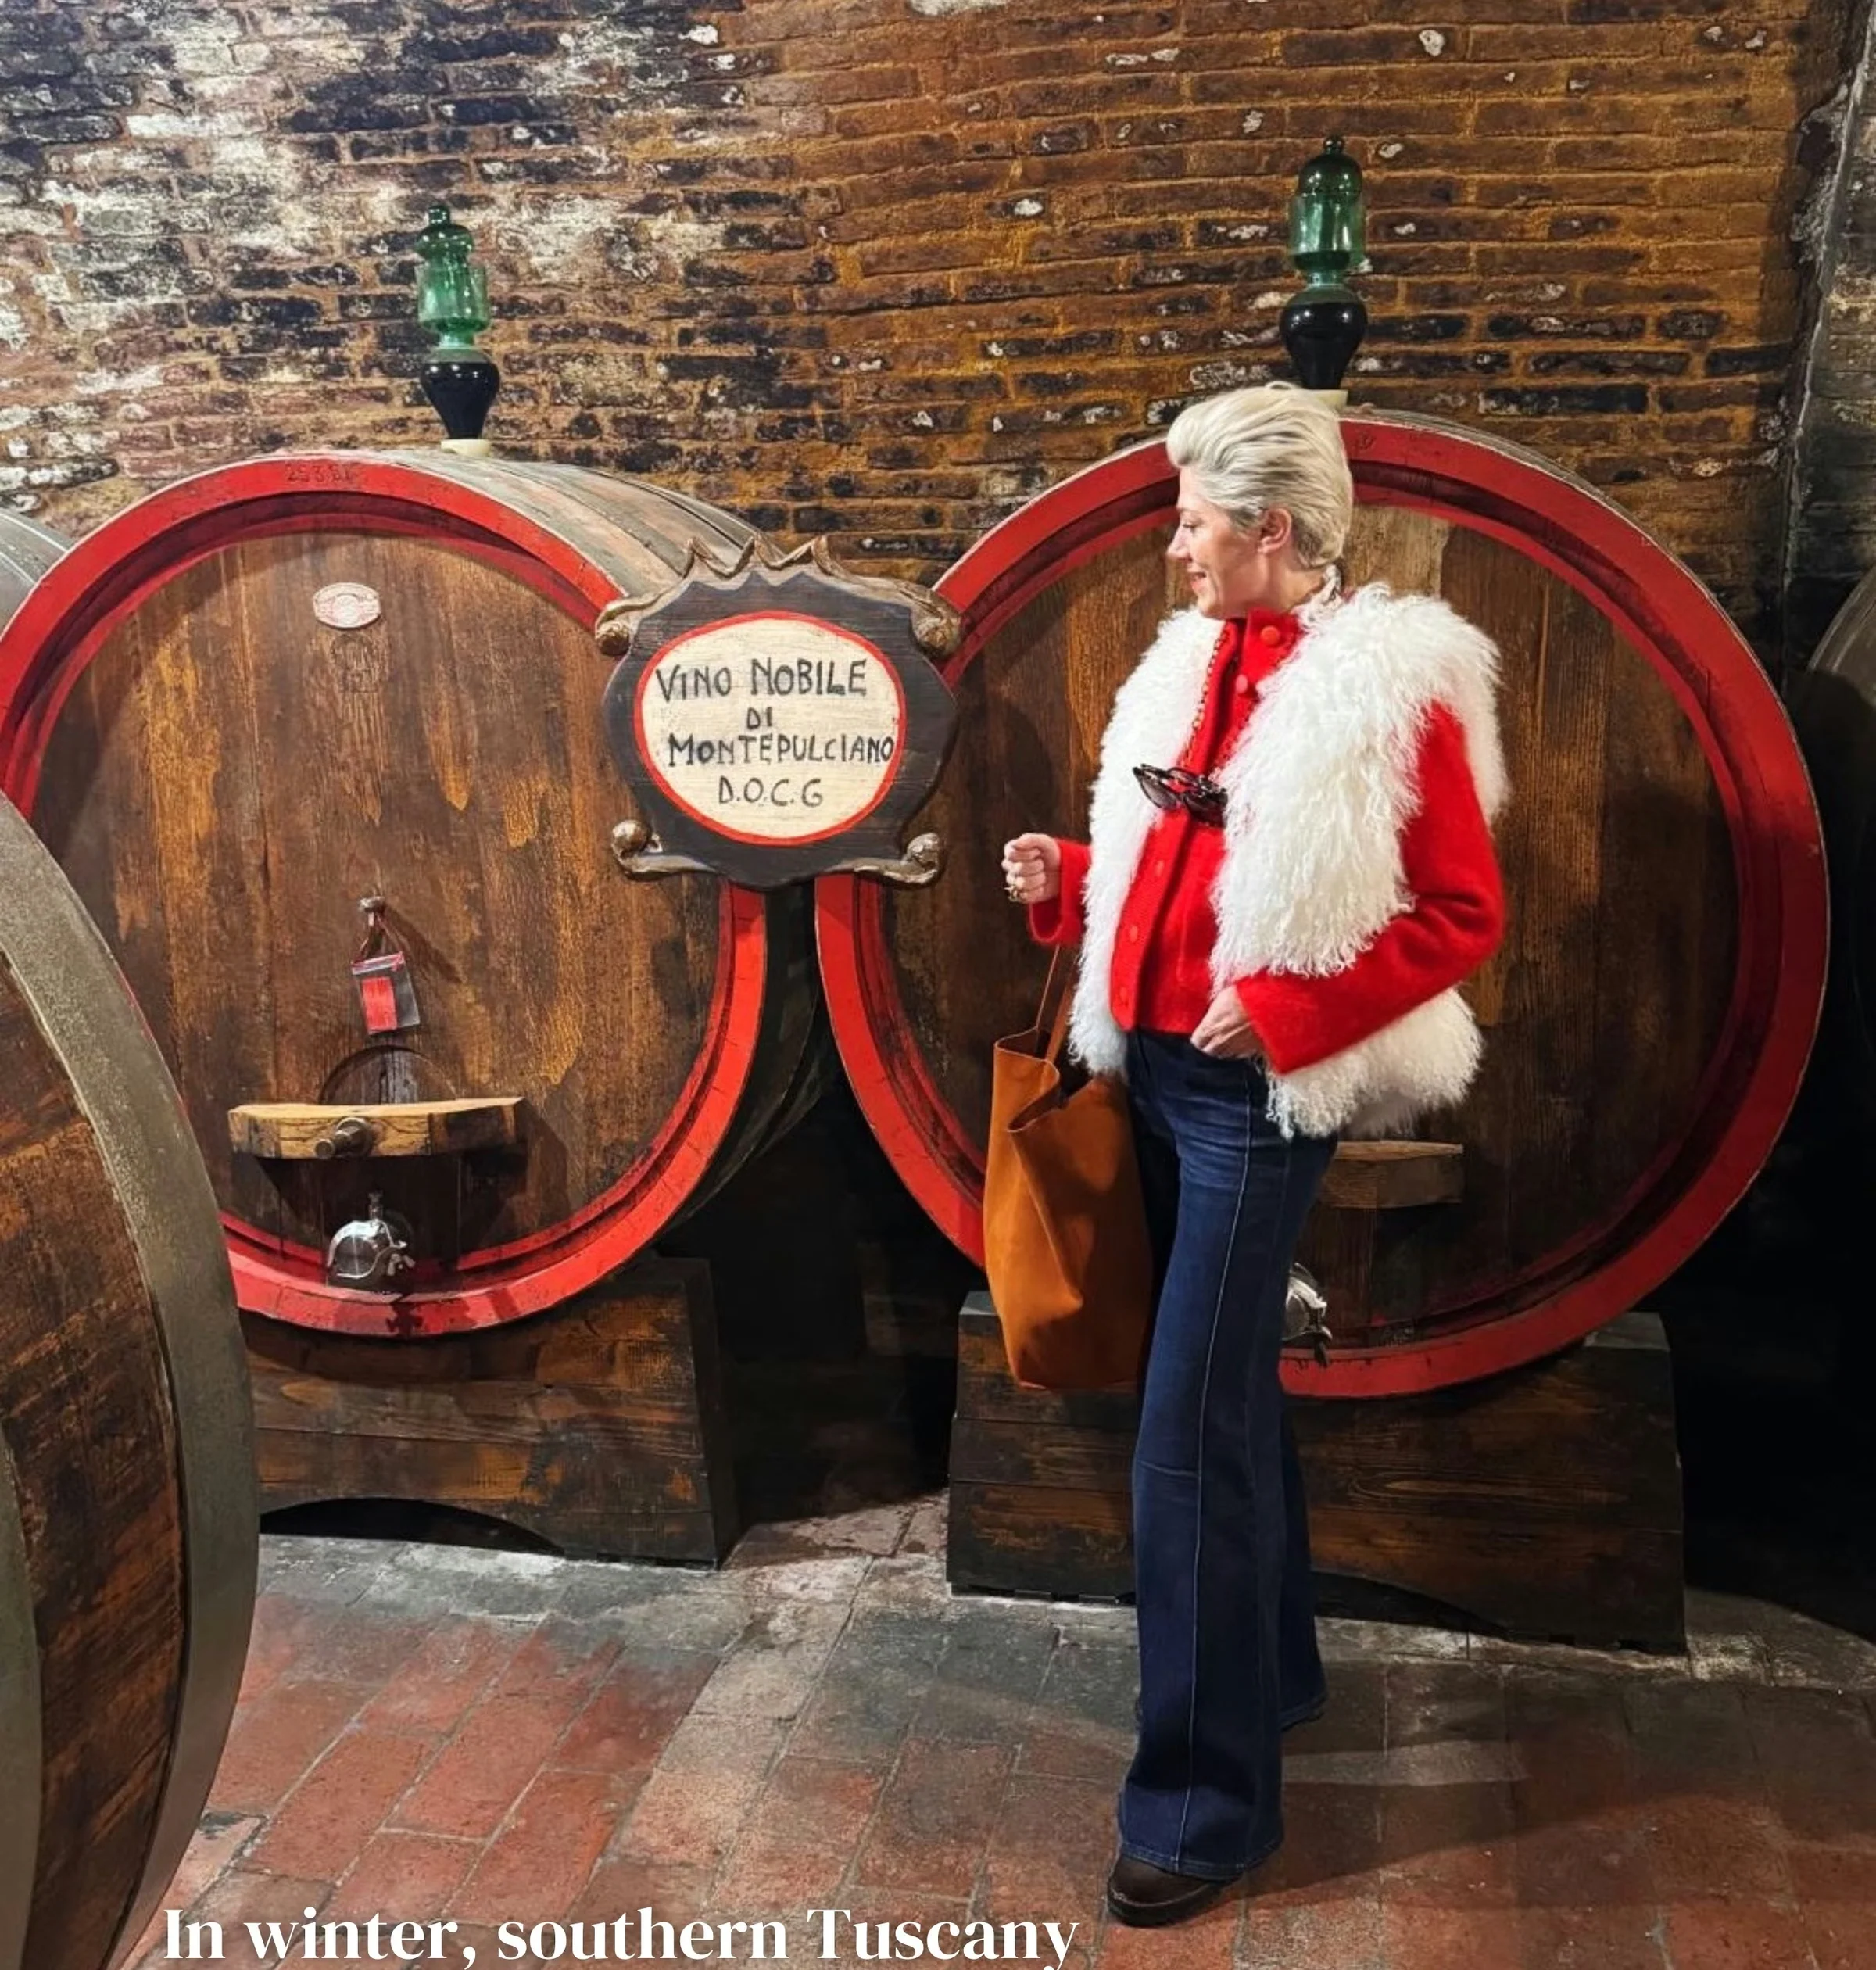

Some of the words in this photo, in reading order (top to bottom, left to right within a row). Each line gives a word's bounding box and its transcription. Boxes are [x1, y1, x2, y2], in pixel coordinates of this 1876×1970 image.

[655, 664, 732, 703] VINO
[750, 657, 867, 697] NOBILE
[746, 707, 773, 729] DI
[668, 732, 895, 766] MONTEPULCIANO
[718, 775, 823, 808] D.O.C.G
